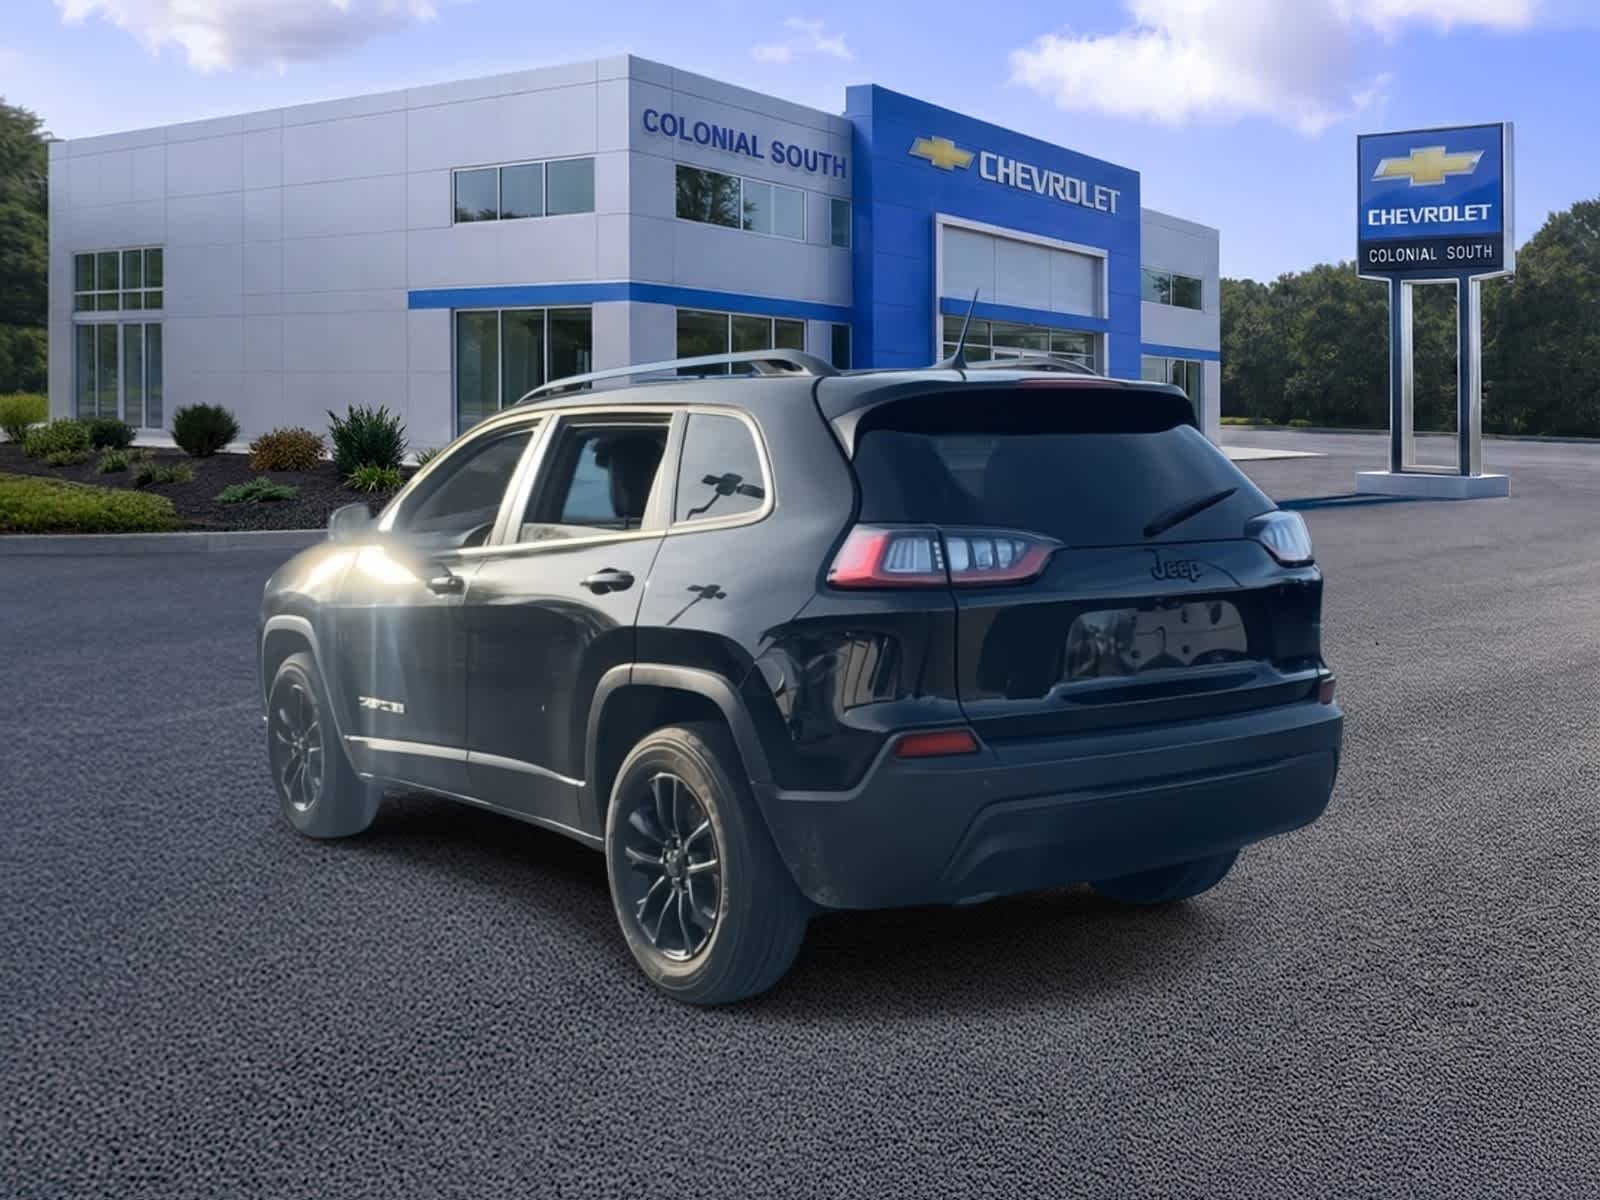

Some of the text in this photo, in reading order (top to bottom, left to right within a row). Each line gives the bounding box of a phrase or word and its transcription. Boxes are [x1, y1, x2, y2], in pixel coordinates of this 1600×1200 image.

[643, 109, 847, 179] COLONIAL SOUTH
[979, 151, 1121, 214] CHEVROLET
[1368, 204, 1492, 226] CHEVROLET
[1369, 244, 1493, 263] COLONIAL SOUTH
[1150, 549, 1202, 583] Jeep
